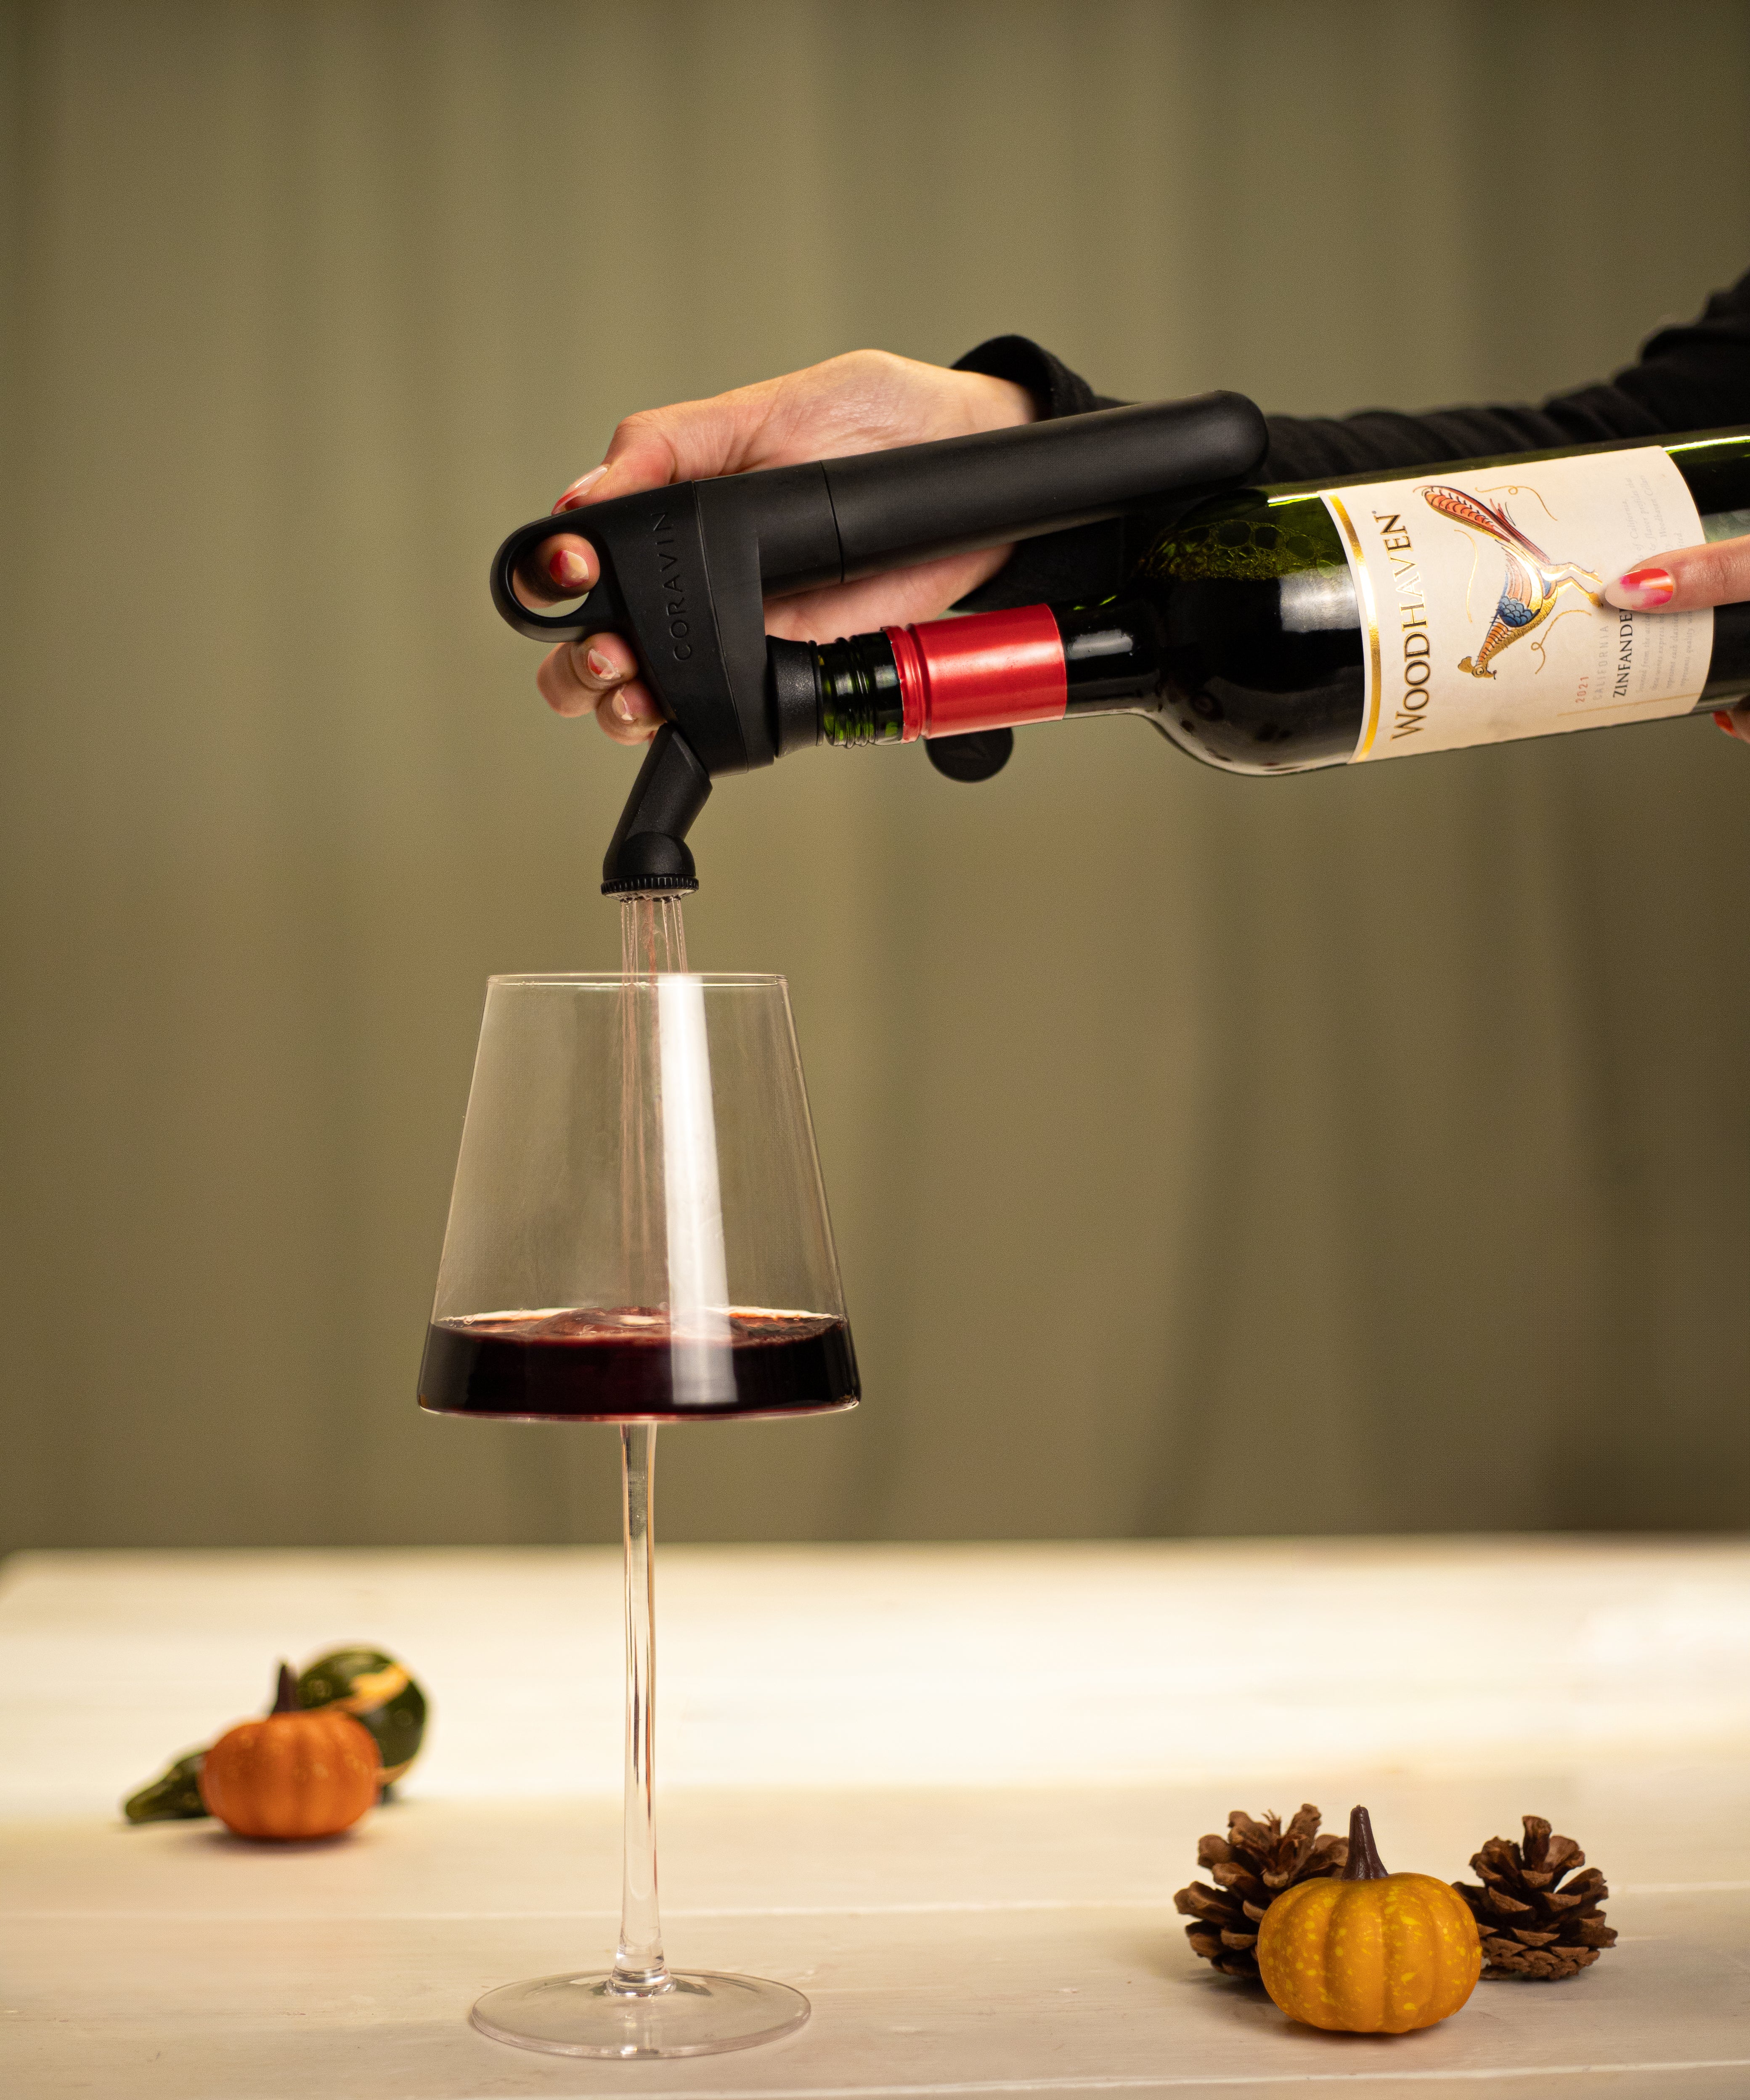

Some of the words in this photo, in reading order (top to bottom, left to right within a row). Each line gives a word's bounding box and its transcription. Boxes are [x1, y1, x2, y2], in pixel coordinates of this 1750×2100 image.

[650, 511, 692, 661] CORAVIN
[1575, 676, 1589, 703] 2021
[1592, 626, 1609, 700] CALIFORNIA
[1613, 608, 1633, 698] ZINFANDE
